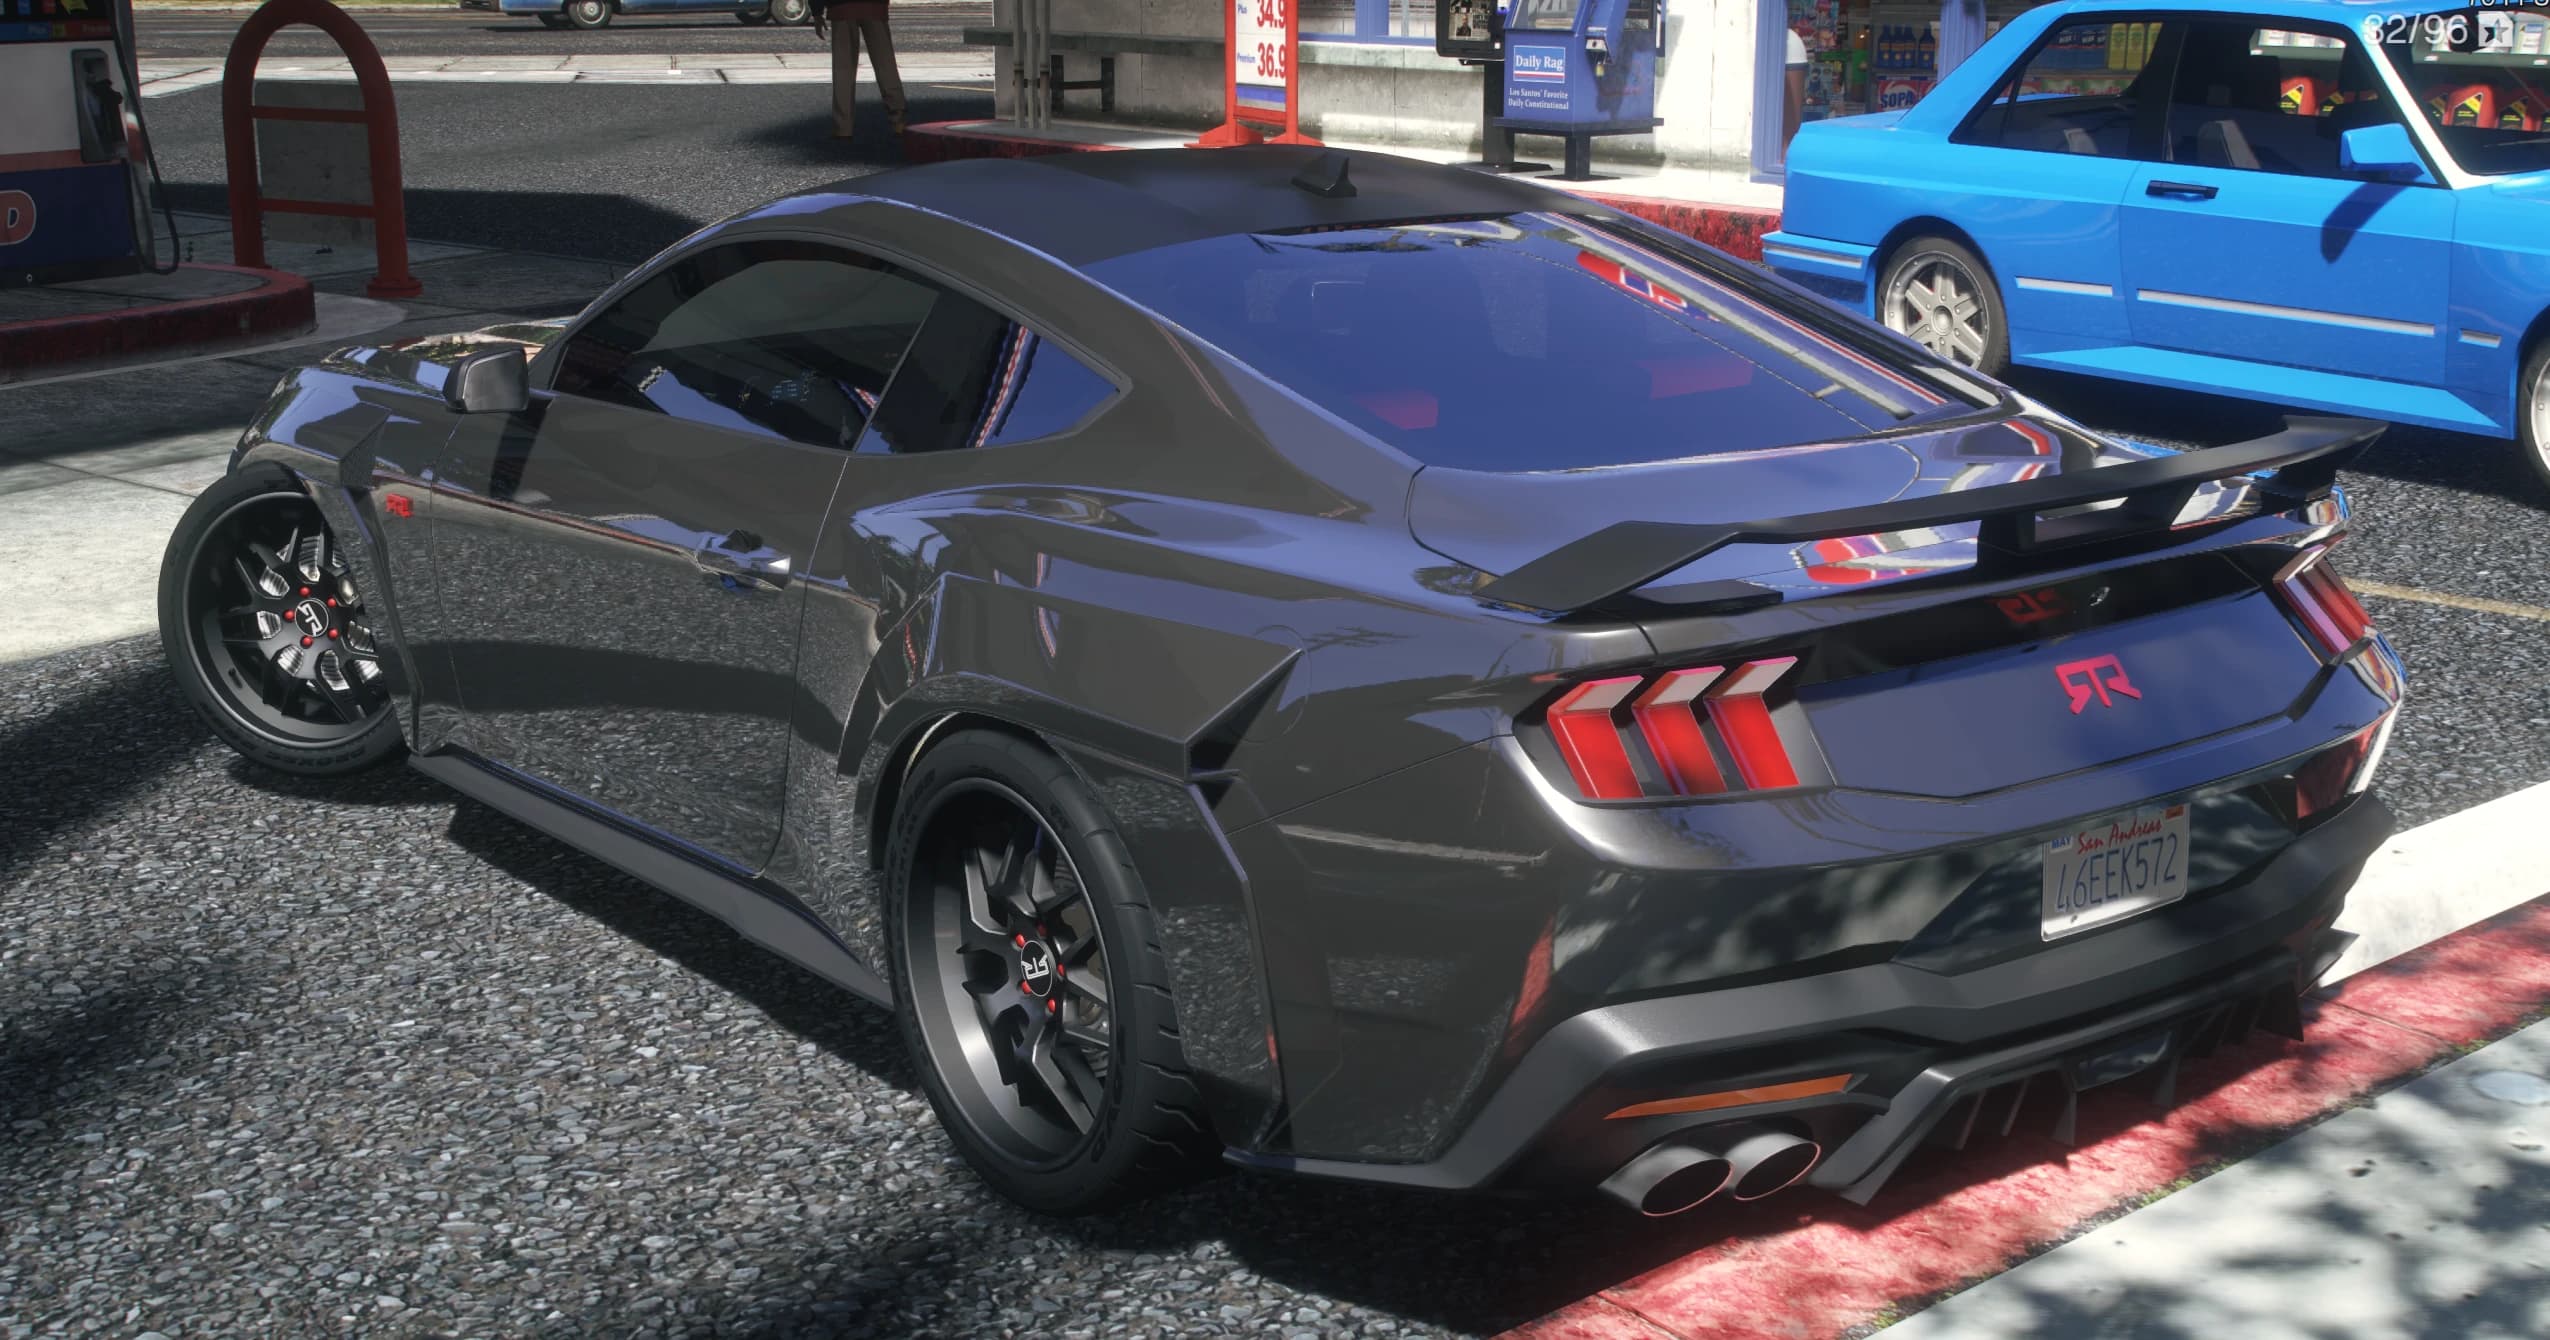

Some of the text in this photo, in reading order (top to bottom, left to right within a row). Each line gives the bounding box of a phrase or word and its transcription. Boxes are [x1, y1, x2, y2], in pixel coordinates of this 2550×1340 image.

[1257, 43, 1286, 78] 36.9
[1515, 55, 1564, 71] Daily Rag
[1509, 88, 1519, 96] Los
[1544, 90, 1568, 99] Favorite
[1508, 98, 1568, 110] Daily Constitutional
[2051, 836, 2072, 849] MAY
[2078, 816, 2162, 855] San Andreas
[2056, 832, 2178, 912] 46EEK572
